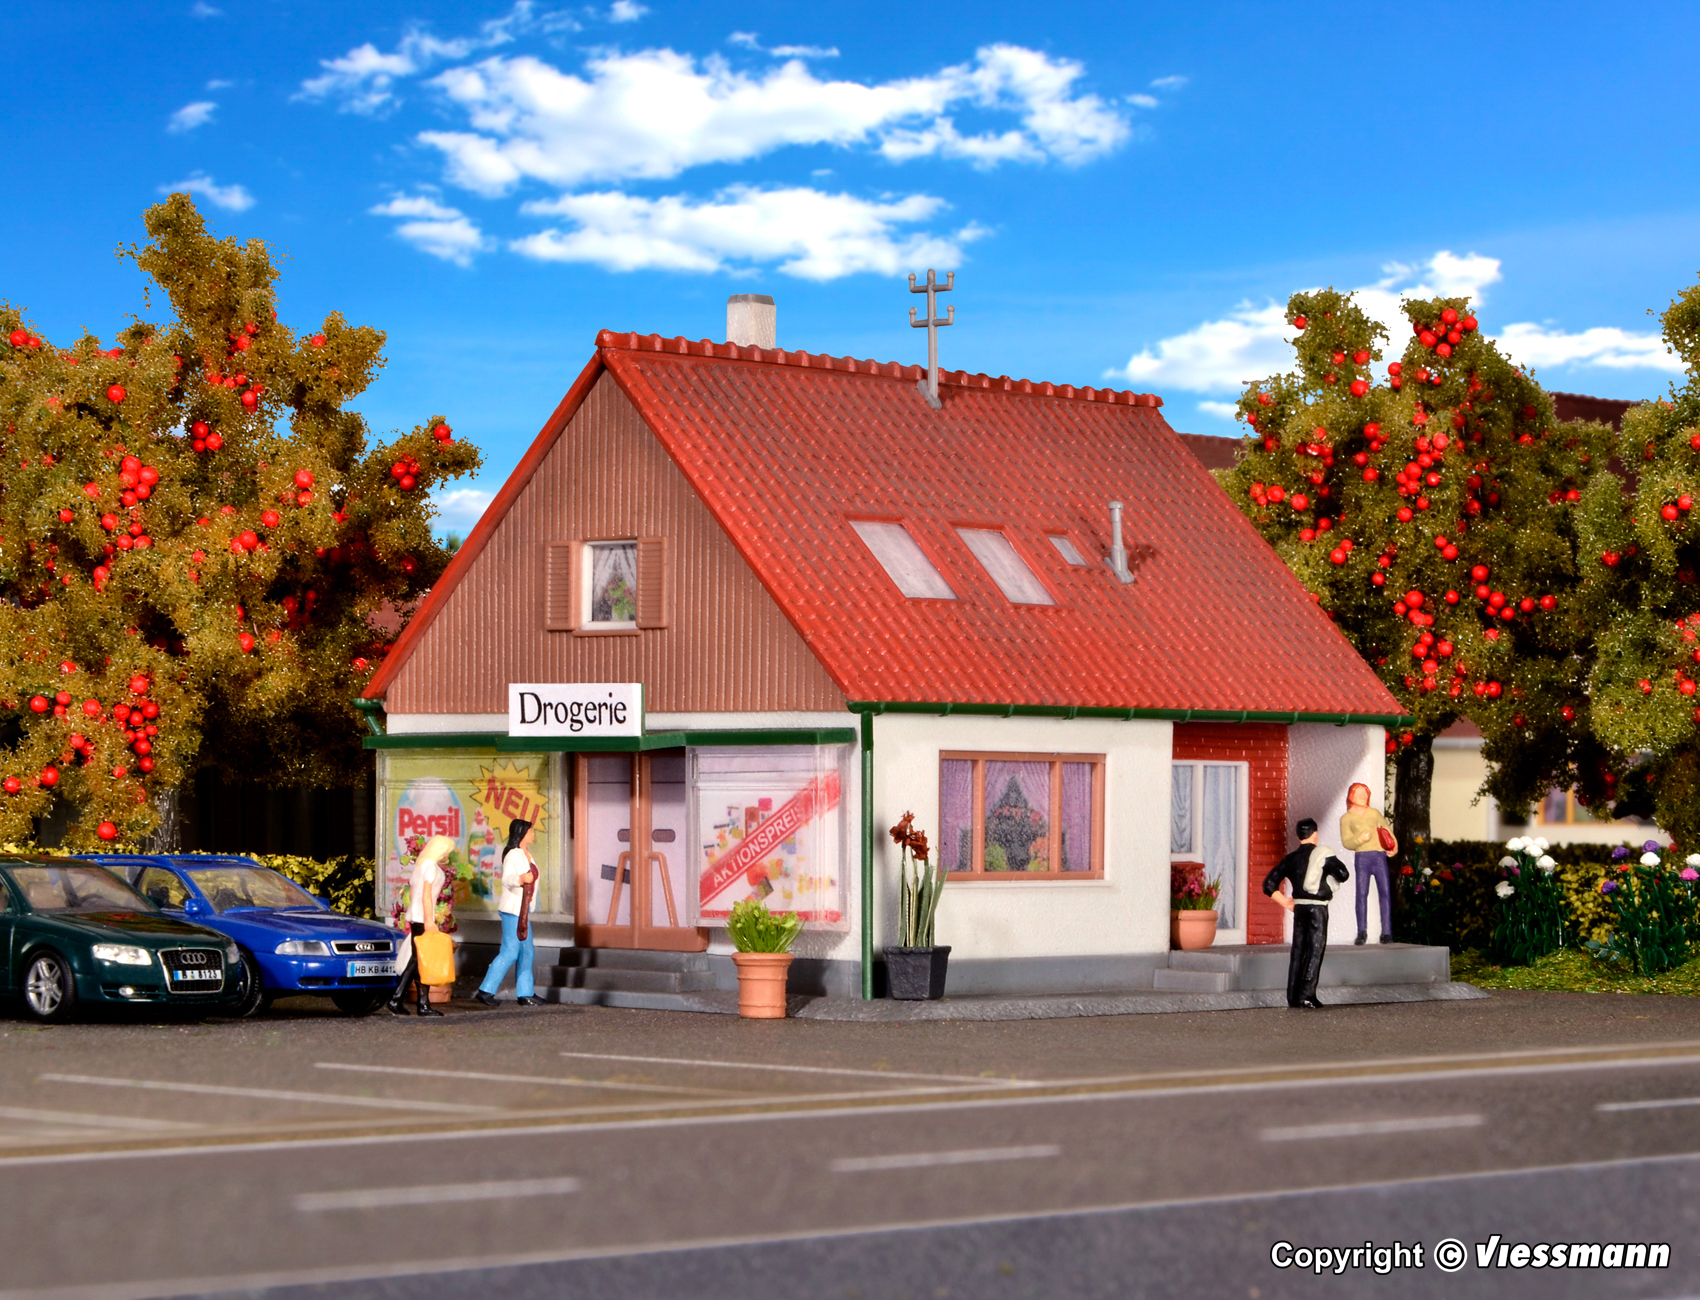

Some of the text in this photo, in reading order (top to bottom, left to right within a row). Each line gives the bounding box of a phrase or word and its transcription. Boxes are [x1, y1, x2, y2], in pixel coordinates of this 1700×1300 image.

[518, 692, 627, 732] Drogerie
[484, 776, 540, 828] NEU
[398, 806, 460, 838] Persil
[355, 966, 366, 974] HB
[368, 966, 379, 974] KB
